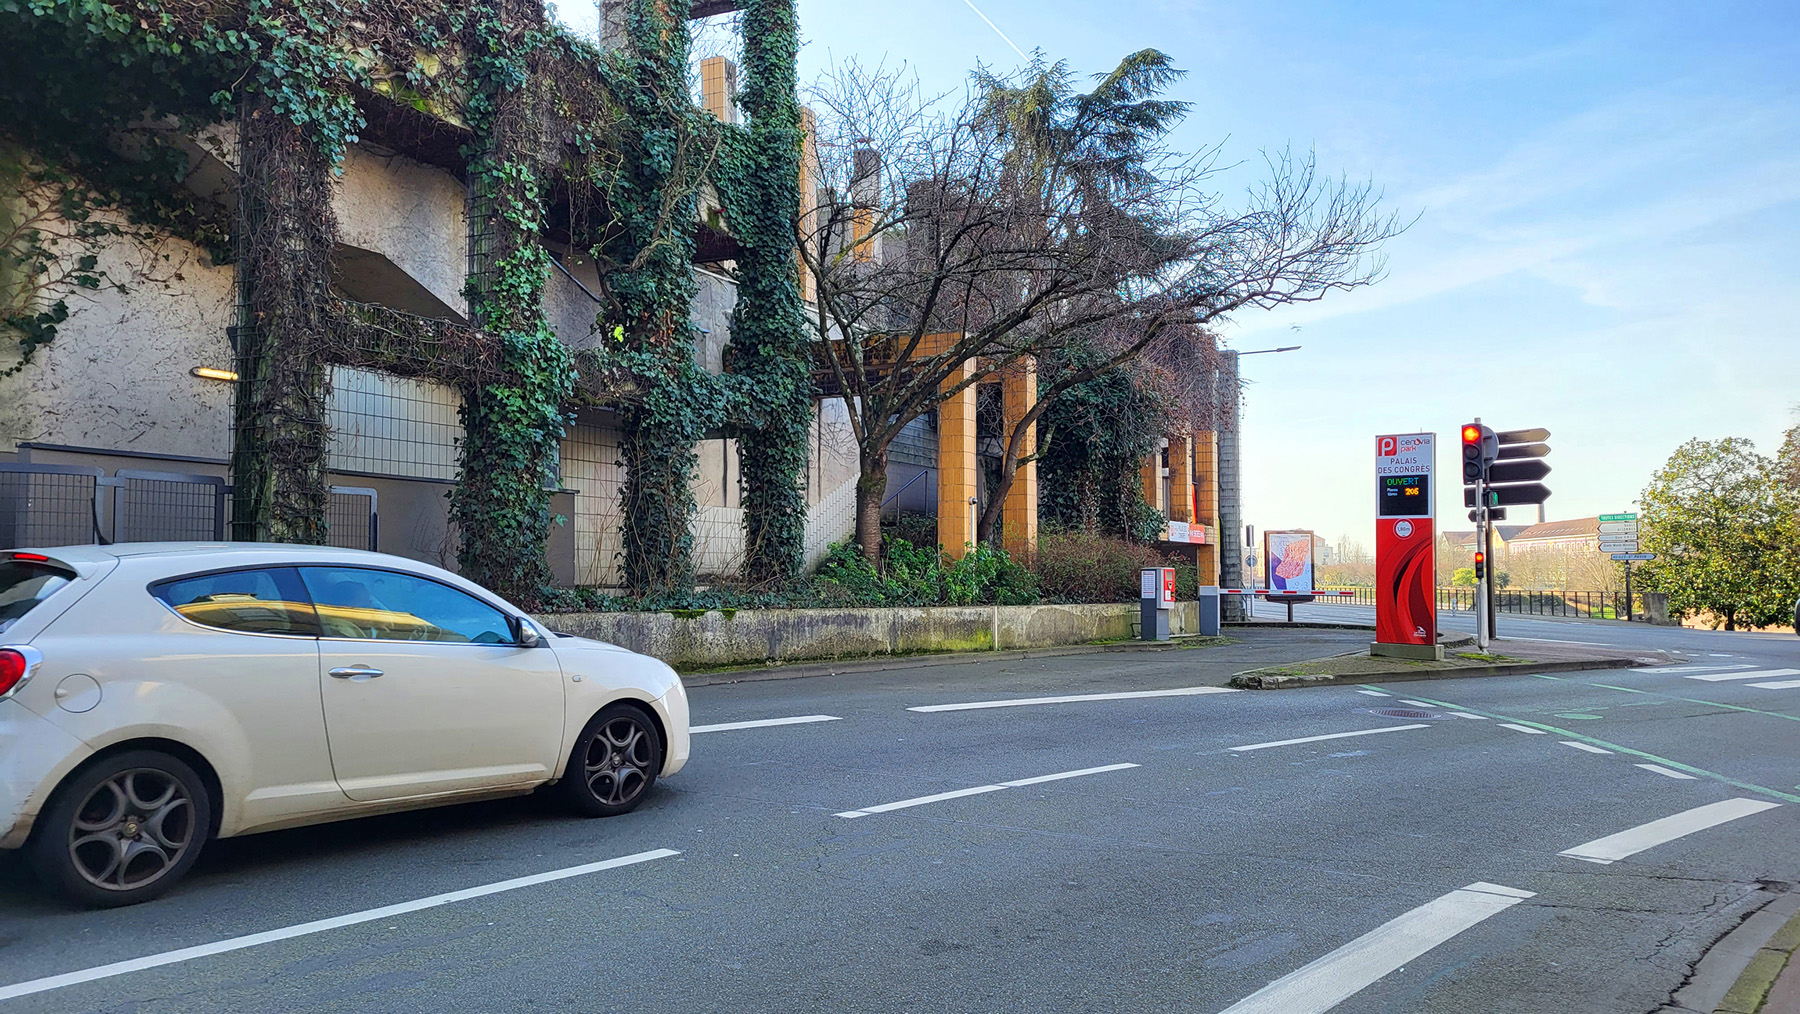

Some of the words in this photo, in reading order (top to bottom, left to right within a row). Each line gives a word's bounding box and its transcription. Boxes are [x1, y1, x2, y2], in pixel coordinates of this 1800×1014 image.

[1400, 445, 1416, 453] park
[1390, 457, 1417, 465] PALAIS
[1378, 466, 1392, 474] DES
[1394, 464, 1430, 474] CONGRÈS
[1387, 477, 1419, 486] OUVERT
